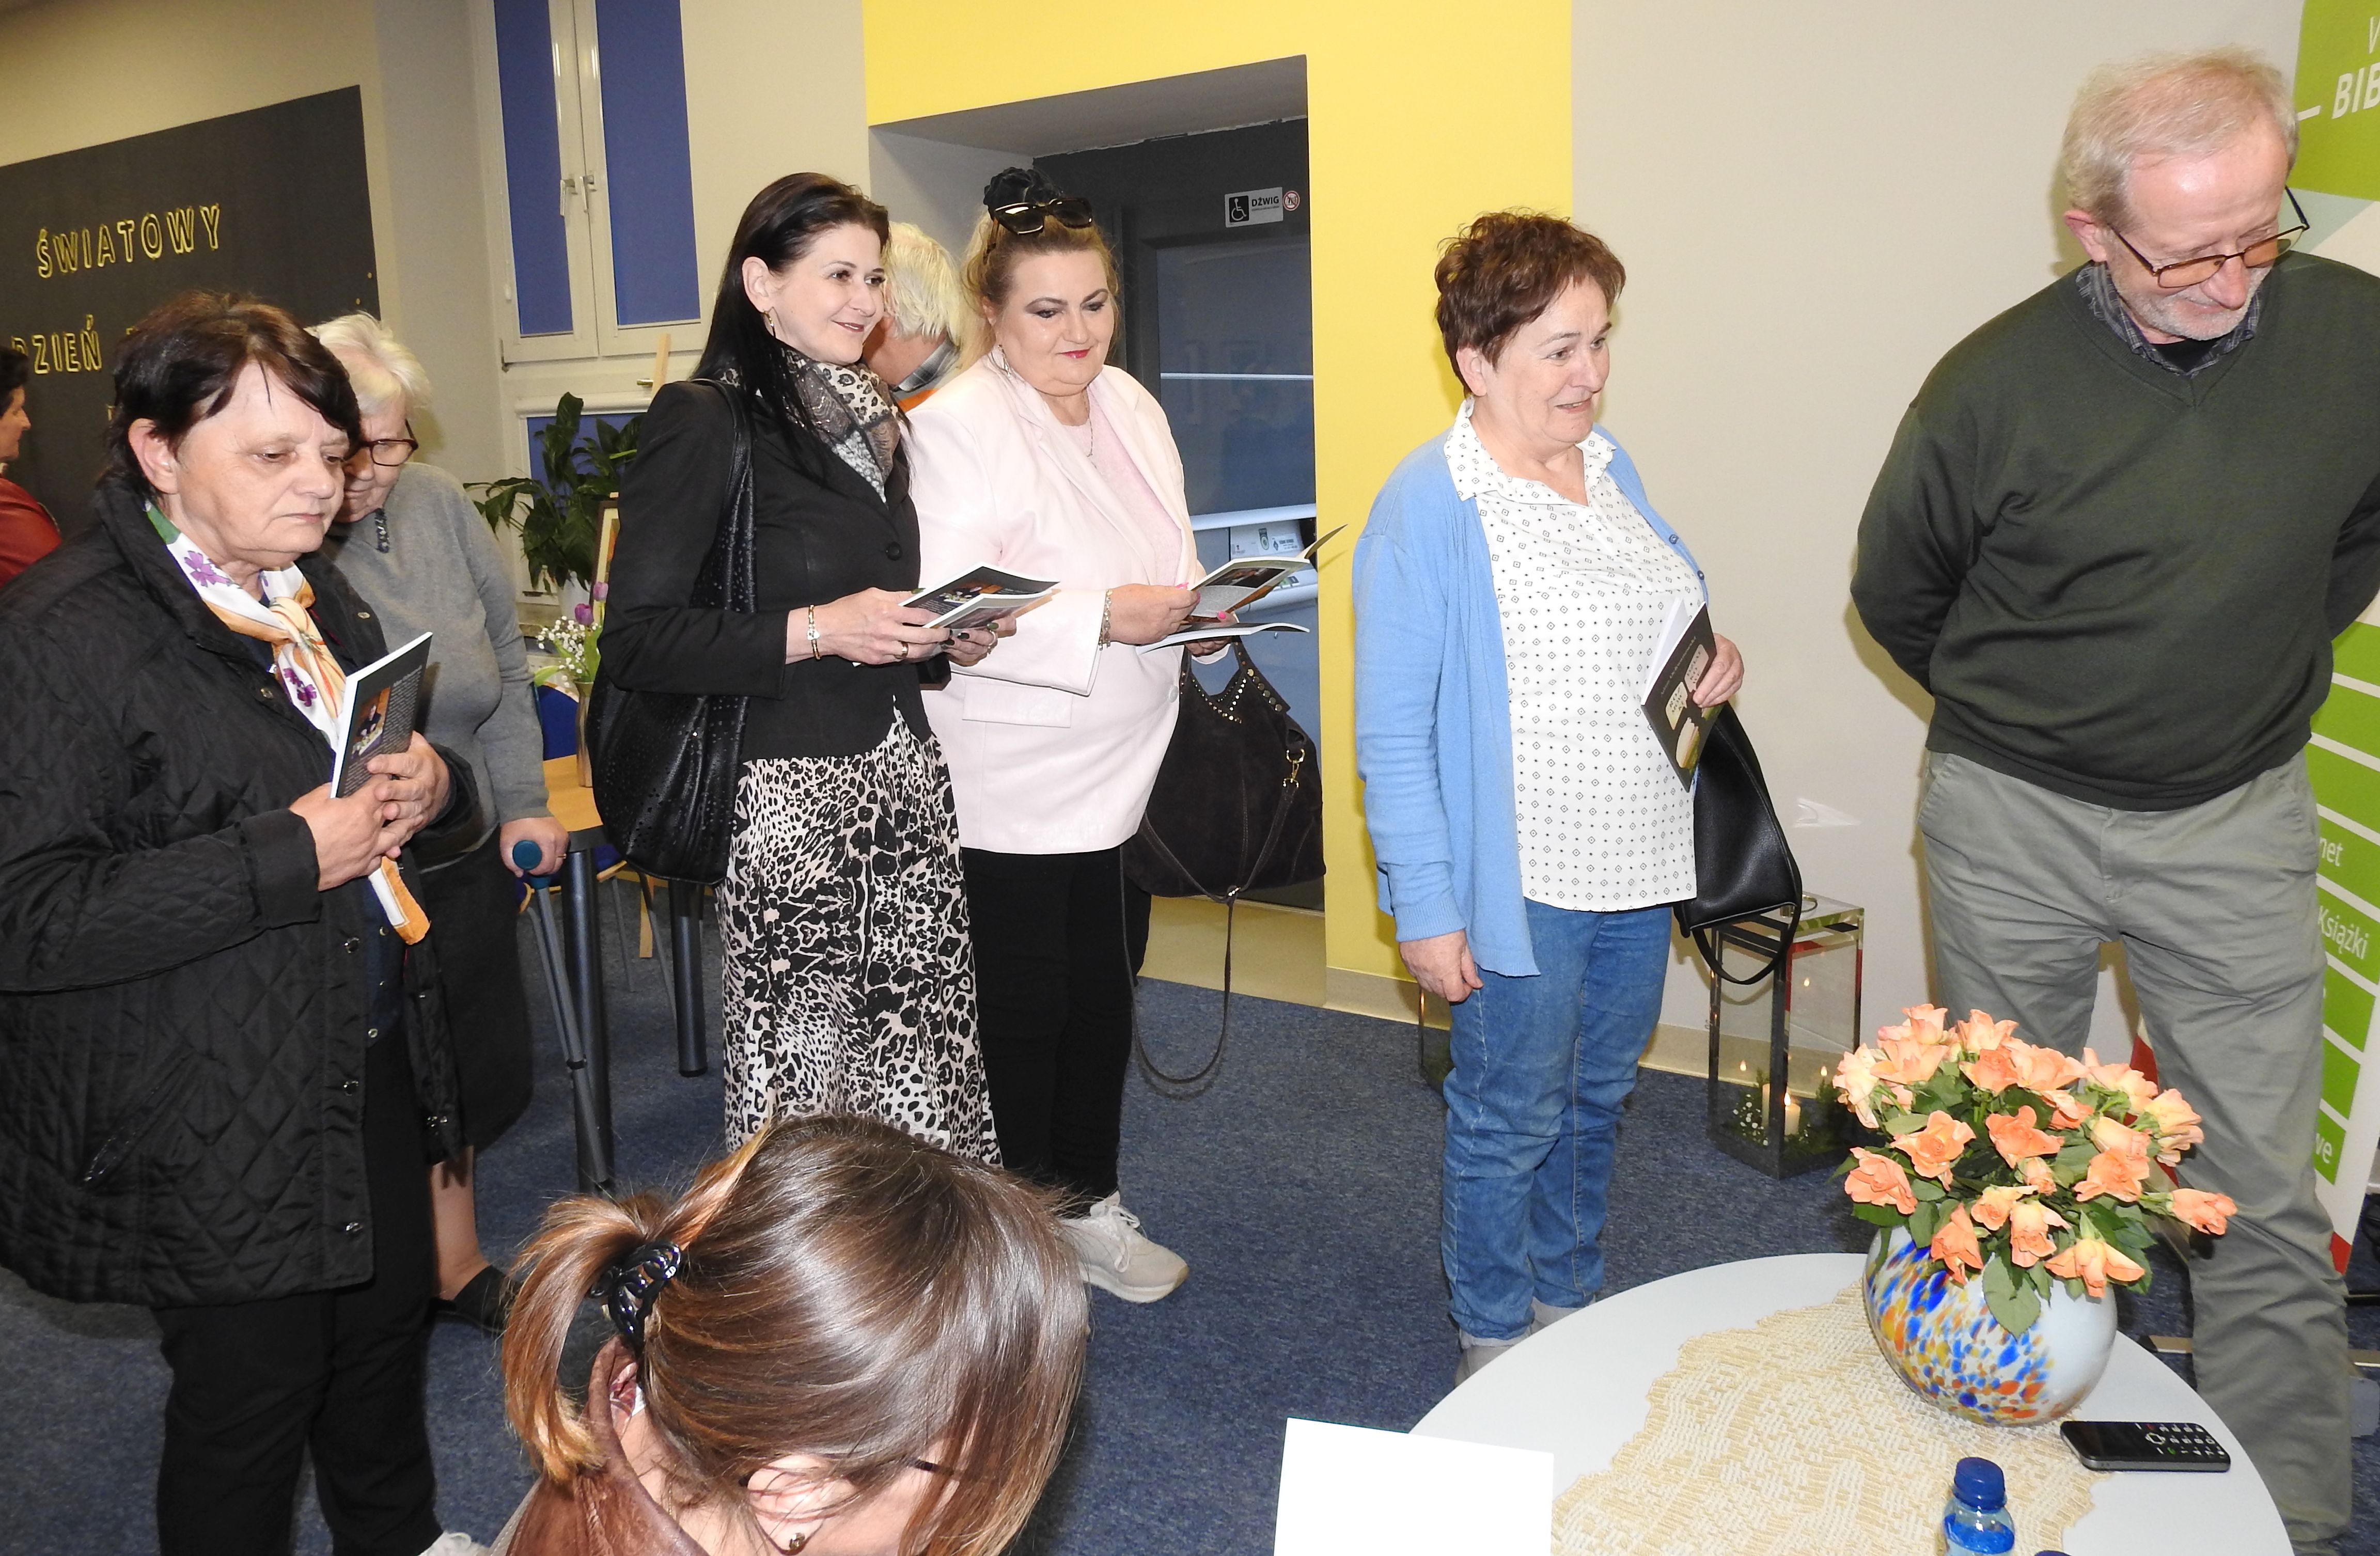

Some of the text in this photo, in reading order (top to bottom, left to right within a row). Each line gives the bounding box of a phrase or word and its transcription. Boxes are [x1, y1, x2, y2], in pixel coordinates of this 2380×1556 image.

[1251, 196, 1279, 207] DŹWIG
[37, 203, 220, 278] ŚWIATOWY
[2318, 905, 2369, 960] Książki
